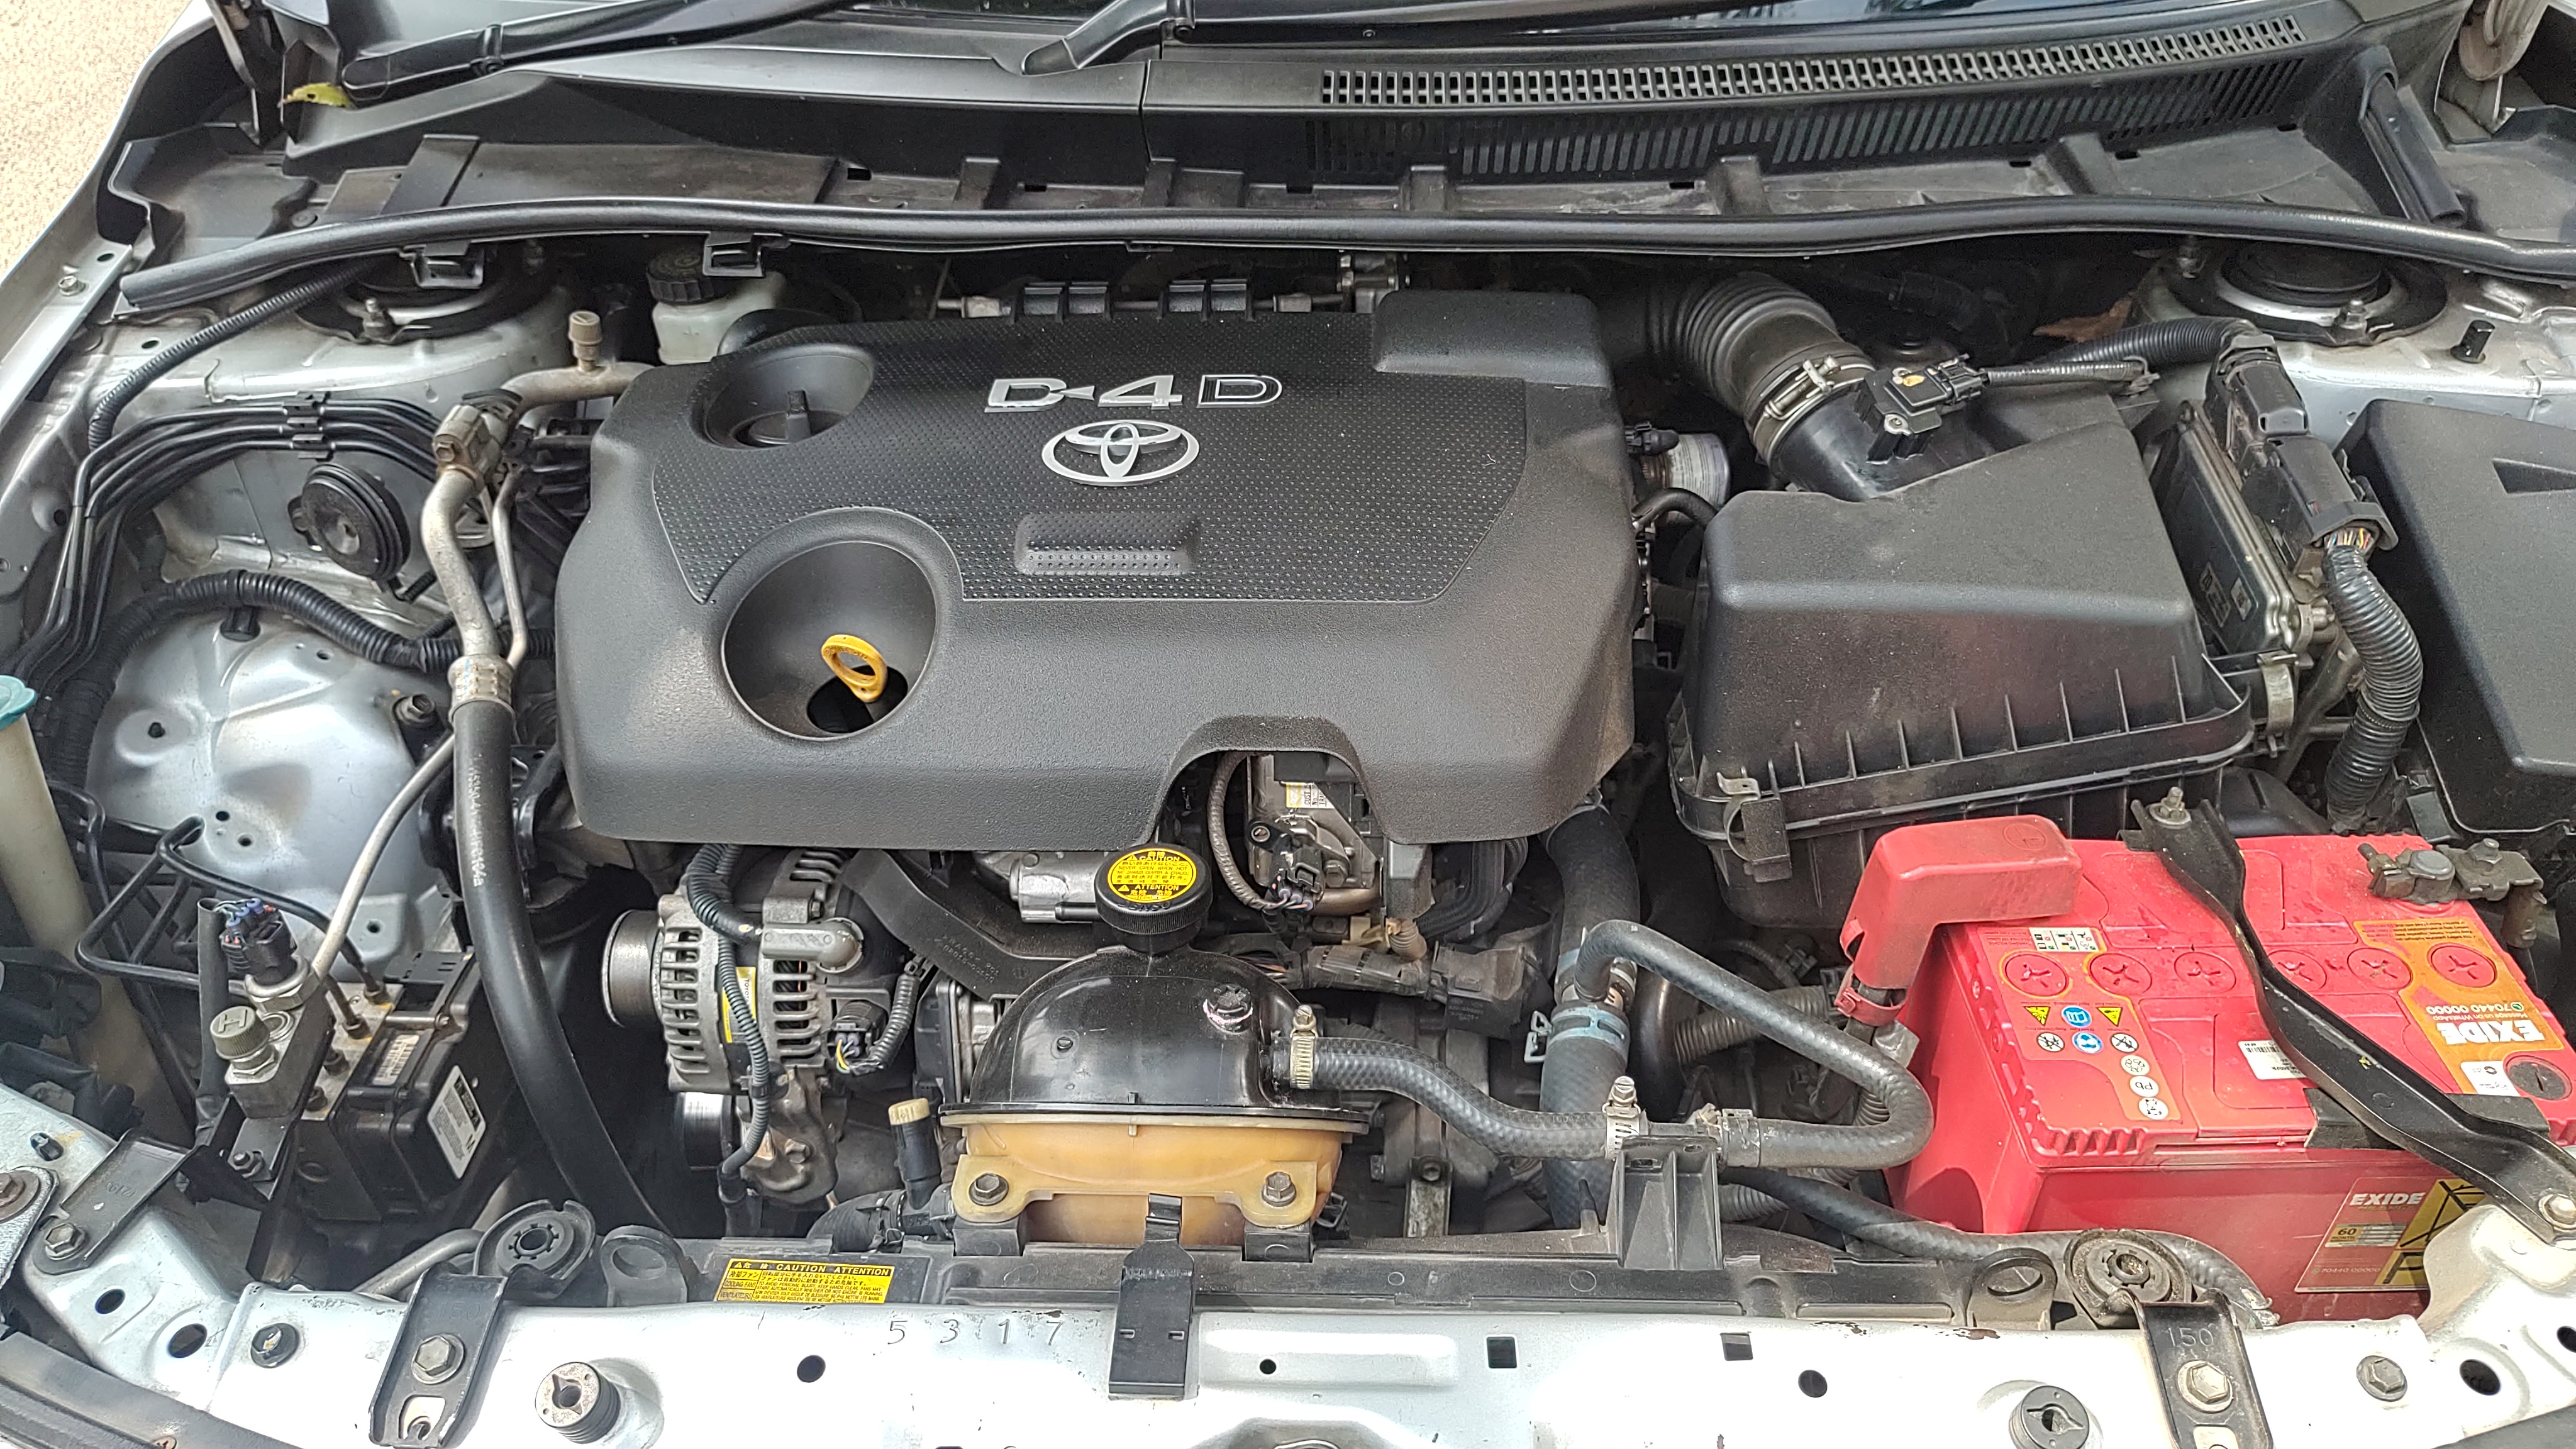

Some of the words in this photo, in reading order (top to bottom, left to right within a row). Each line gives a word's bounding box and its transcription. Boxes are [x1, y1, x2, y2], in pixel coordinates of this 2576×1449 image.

[2426, 1004, 2469, 1014] 00000
[2470, 1003, 2512, 1013] 70440
[2436, 1019, 2545, 1045] EXIDE
[2135, 1082, 2153, 1091] Pb
[2350, 1192, 2426, 1206] EXIDE
[2338, 1228, 2357, 1236] 60
[775, 1263, 826, 1272] CAUTION
[833, 1266, 890, 1277] ATTENTION
[2167, 1327, 2214, 1347] 150
